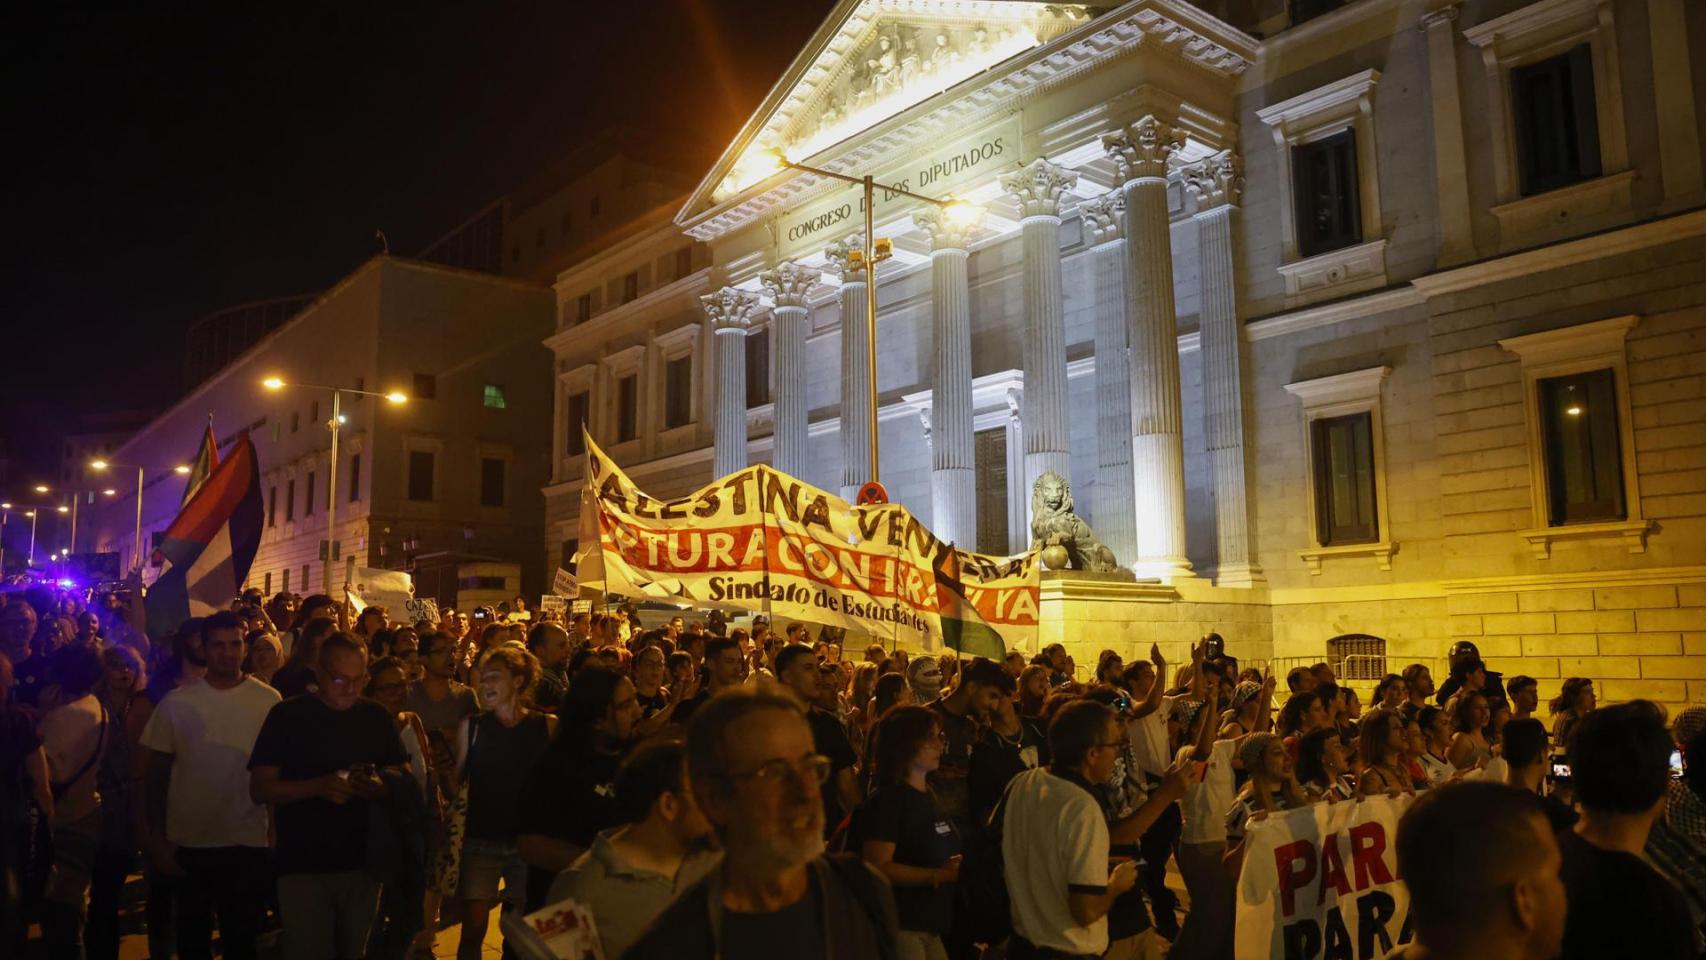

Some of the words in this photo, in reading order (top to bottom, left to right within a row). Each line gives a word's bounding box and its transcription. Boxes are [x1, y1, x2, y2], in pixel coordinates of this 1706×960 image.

[788, 204, 851, 242] CONGRESO
[884, 179, 909, 202] LOS
[919, 138, 1003, 188] DIPUTADOS
[778, 536, 870, 590] CON
[996, 589, 1039, 621] YA
[814, 589, 838, 612] de
[1274, 821, 1402, 917] PAR
